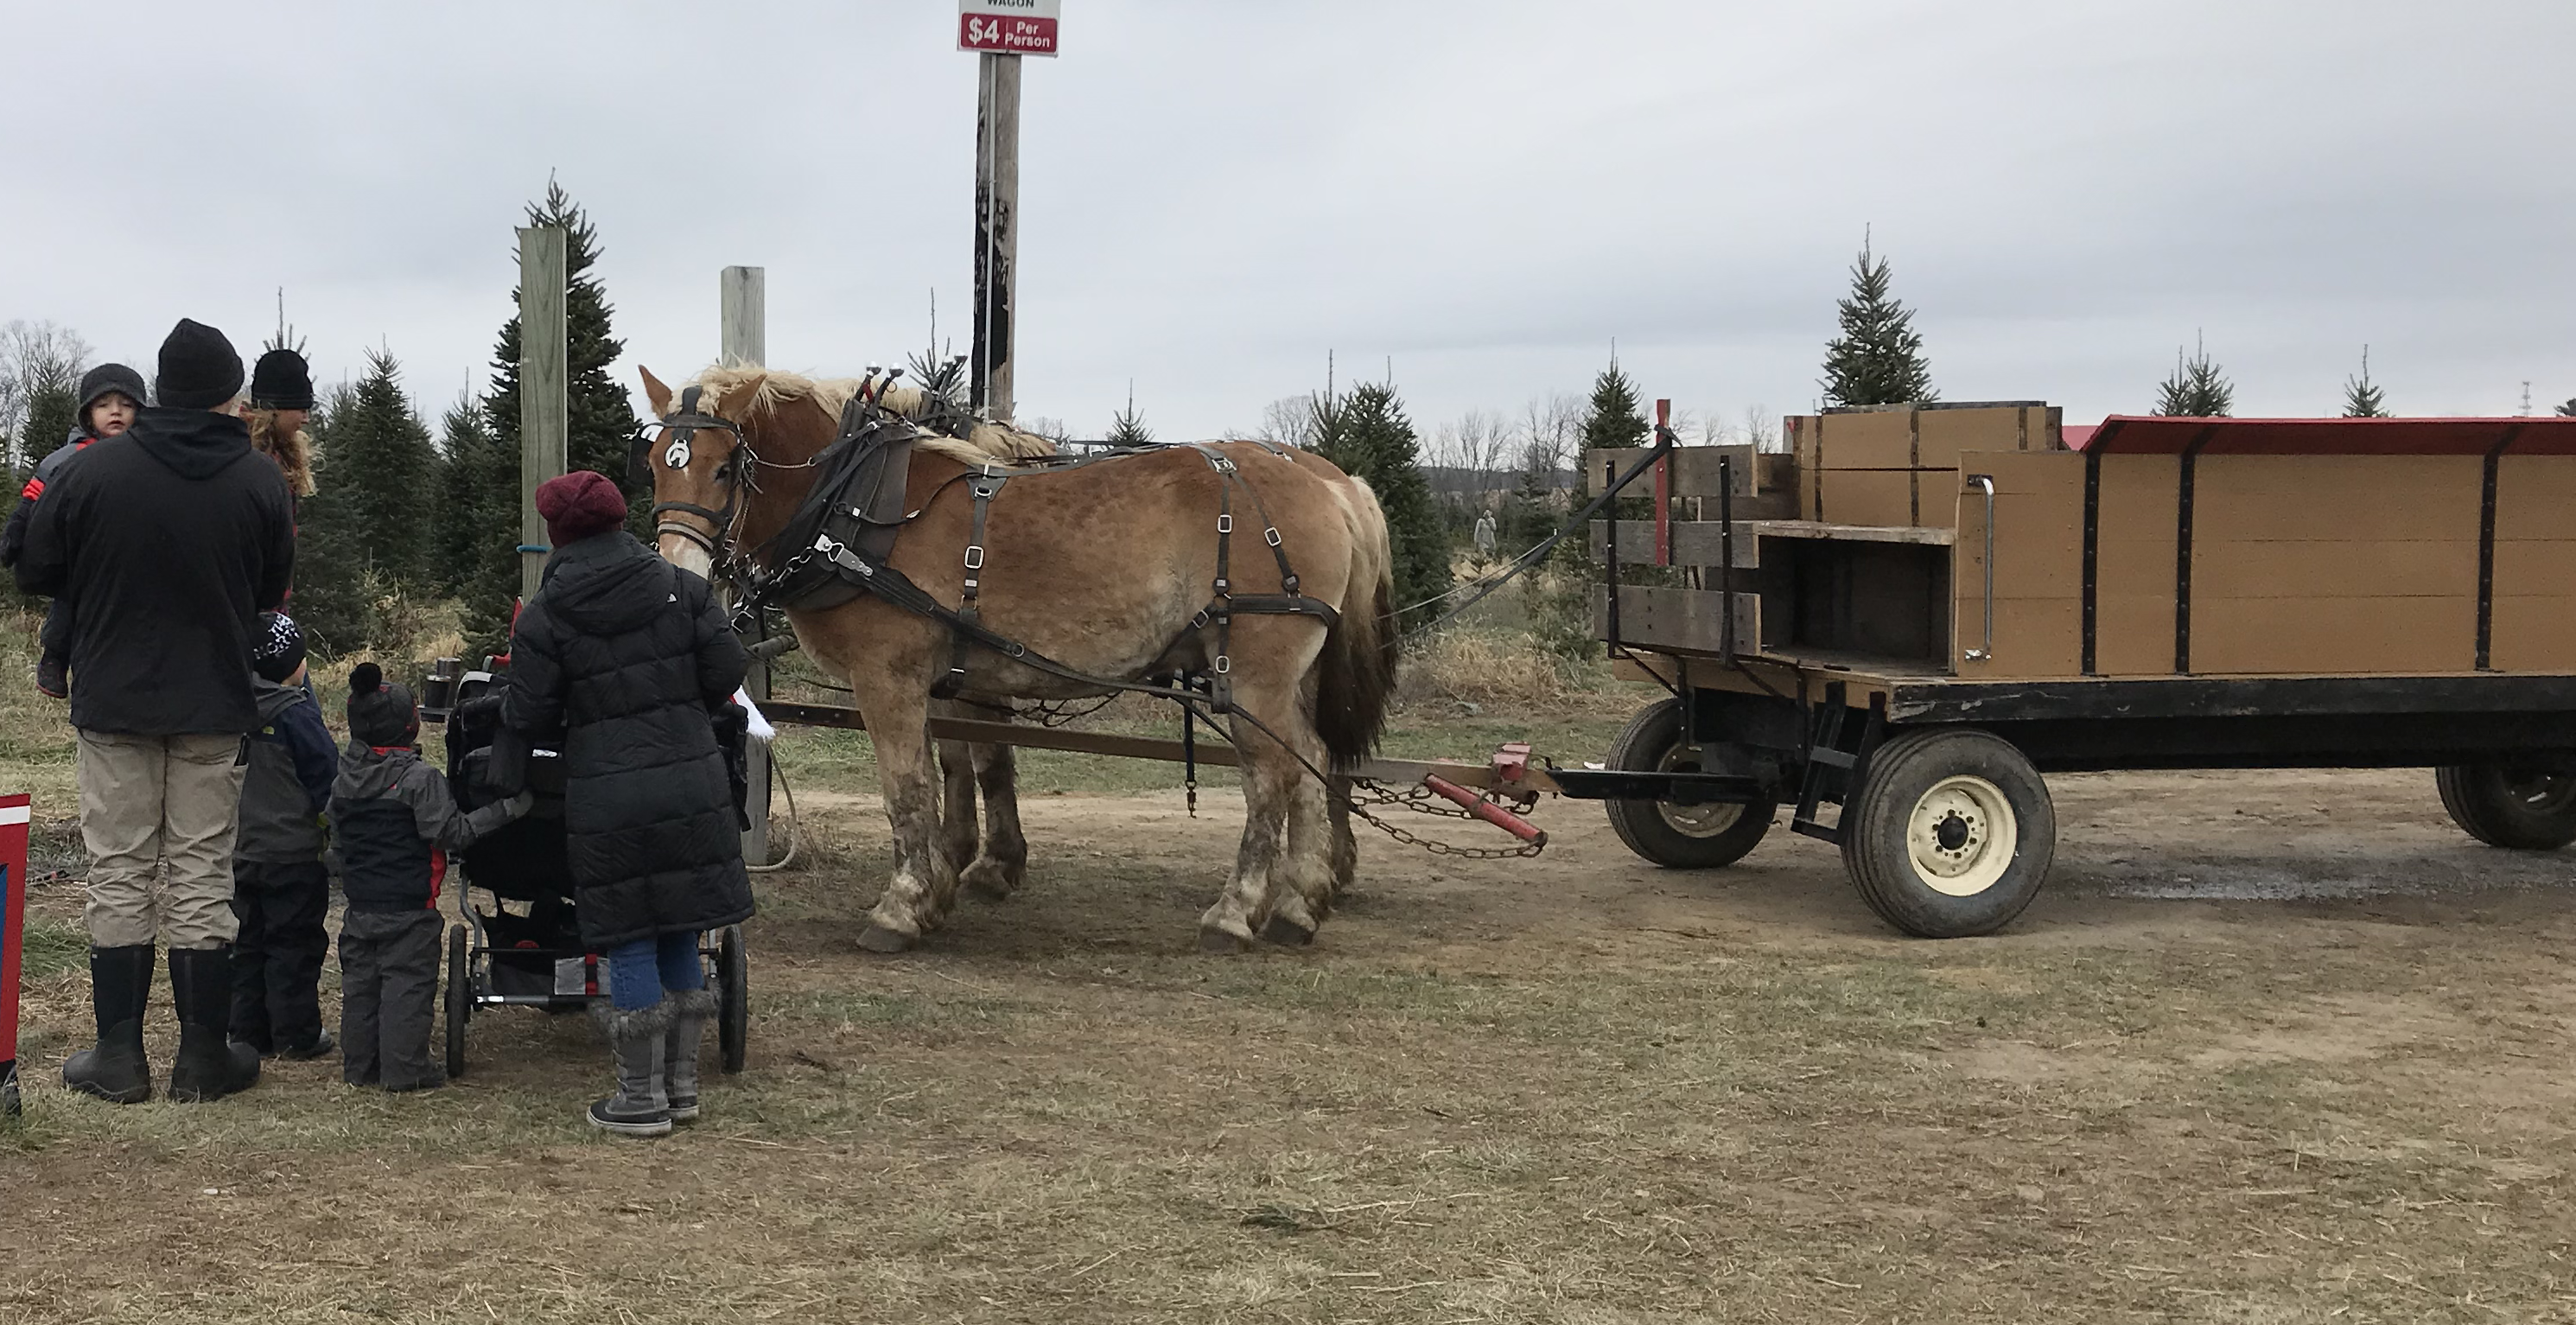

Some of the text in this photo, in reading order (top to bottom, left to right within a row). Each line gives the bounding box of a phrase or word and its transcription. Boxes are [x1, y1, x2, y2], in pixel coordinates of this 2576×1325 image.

[968, 16, 1000, 45] $4
[1016, 21, 1039, 35] Per
[1005, 32, 1050, 48] Person
